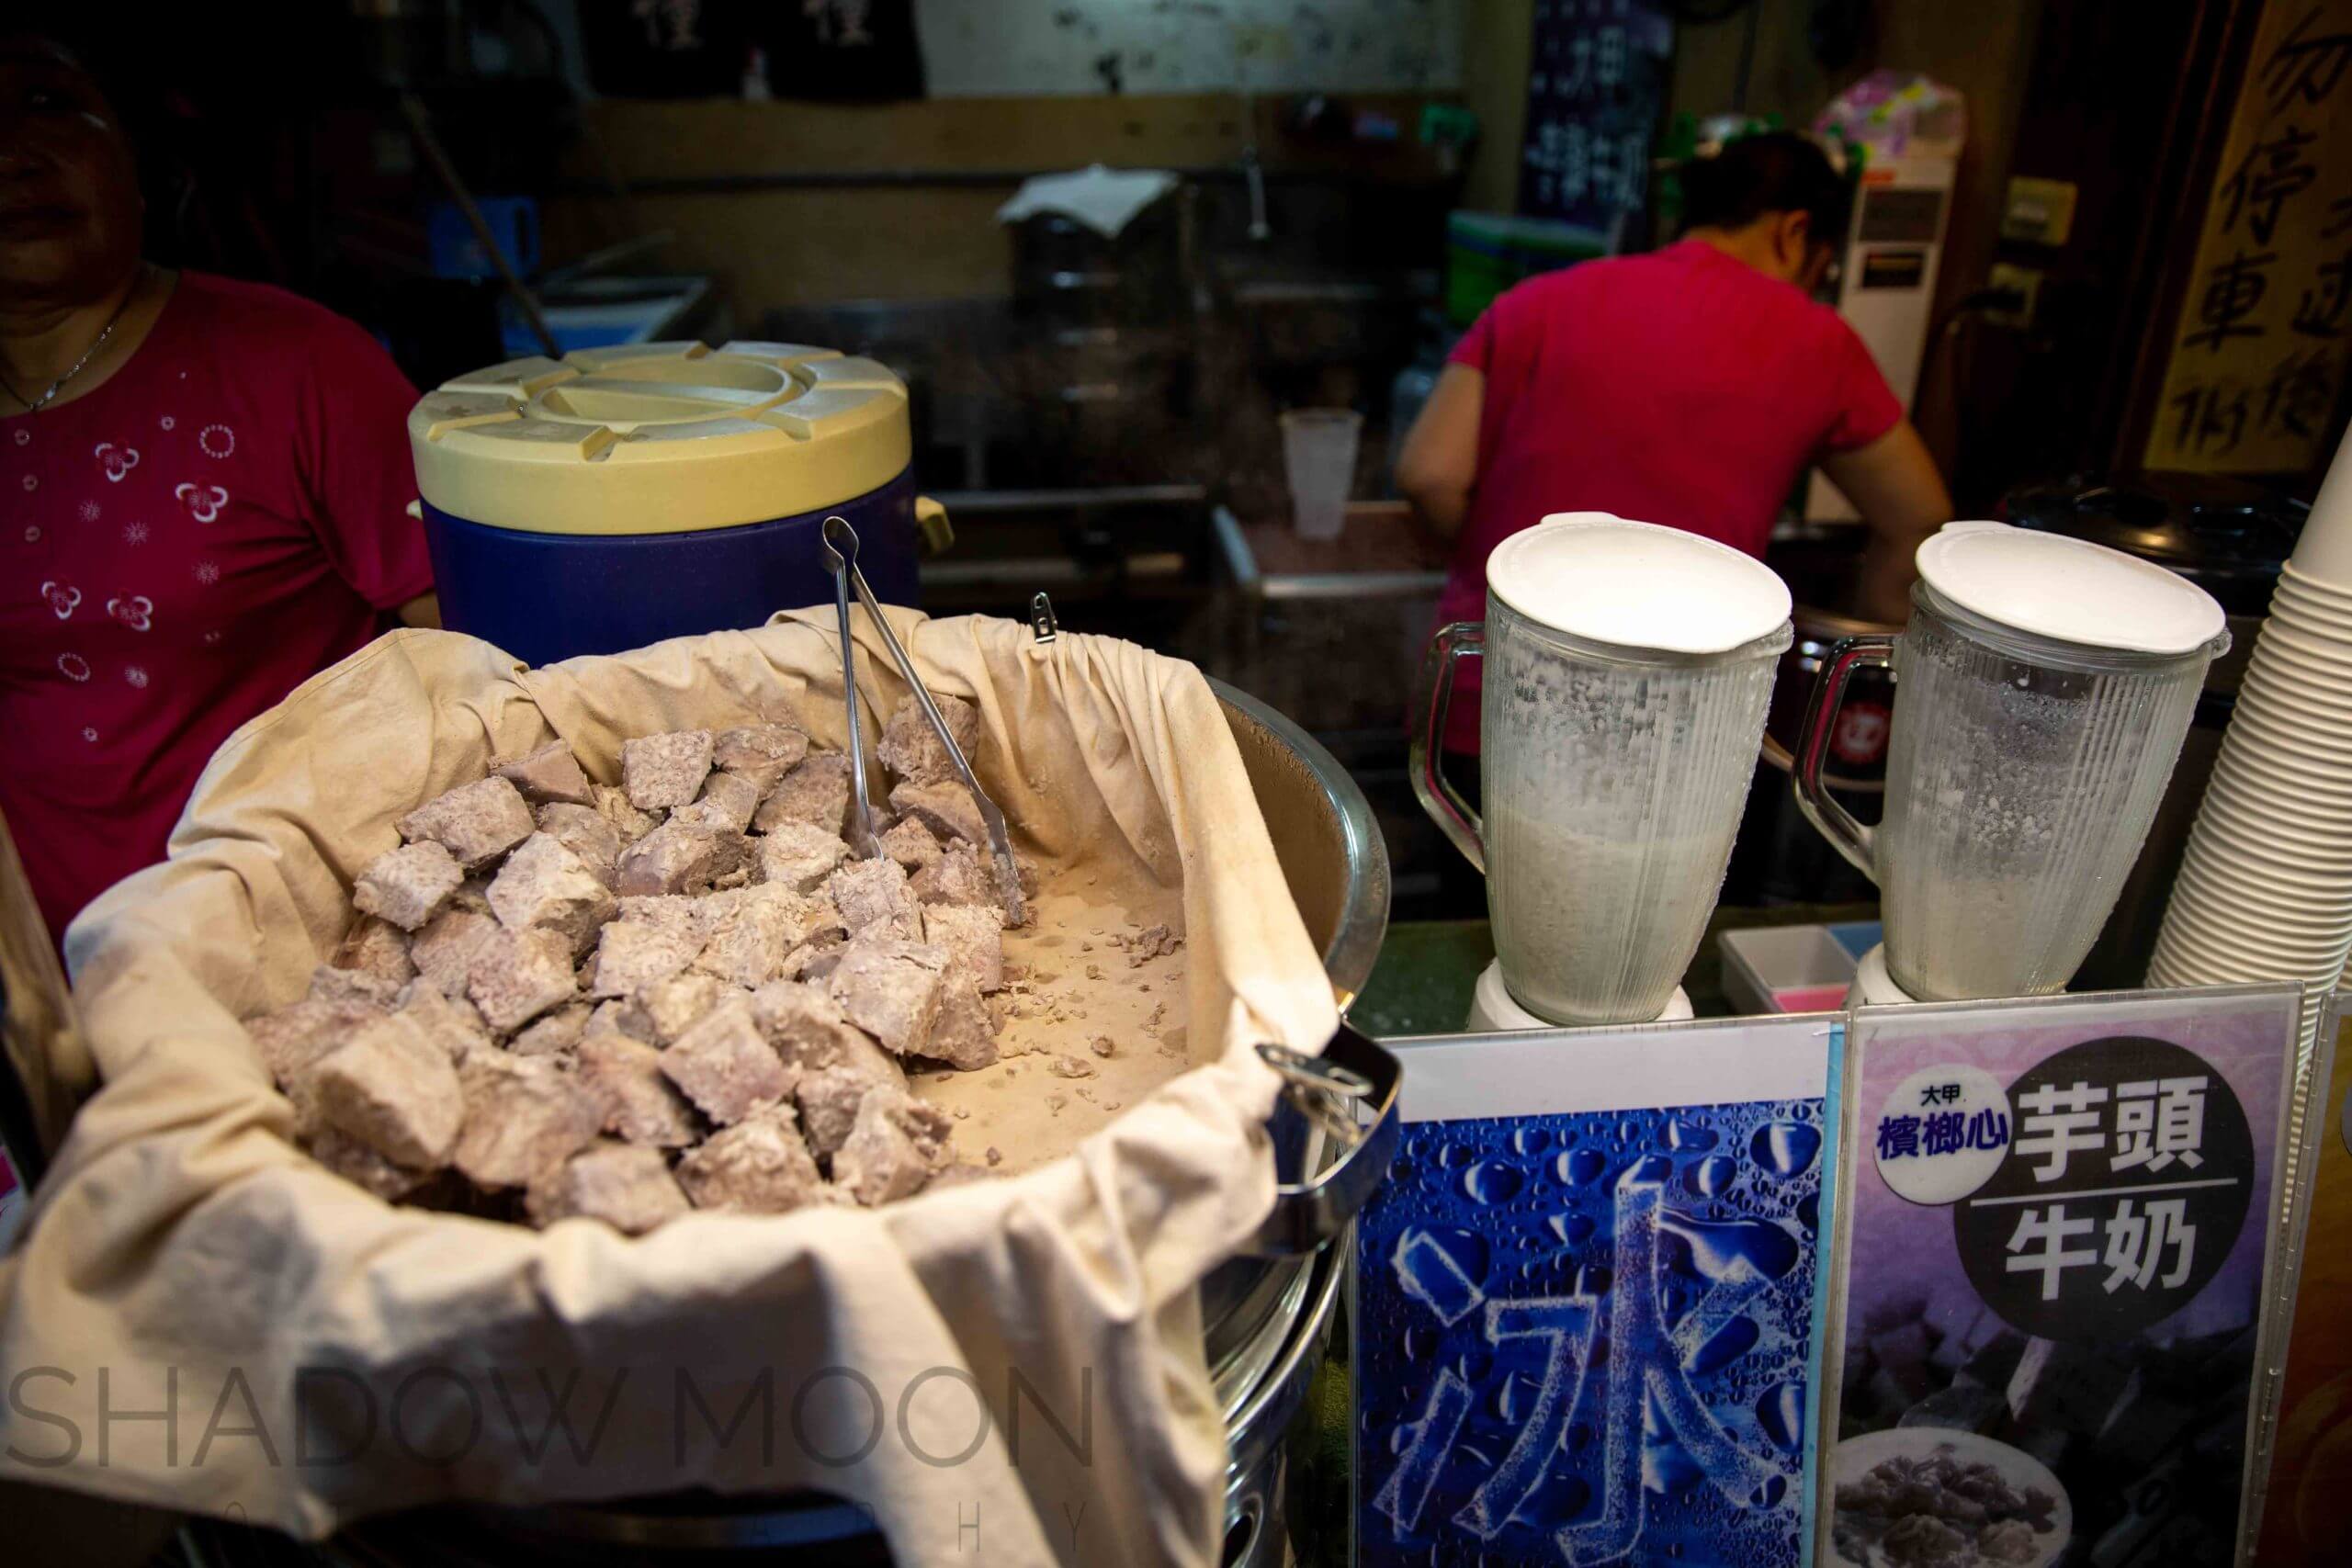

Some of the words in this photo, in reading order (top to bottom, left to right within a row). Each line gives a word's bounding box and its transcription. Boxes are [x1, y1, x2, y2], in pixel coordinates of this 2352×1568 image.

[1876, 1107, 2009, 1160] 檳榔心
[1920, 1083, 1961, 1107] 大甲
[2015, 1076, 2209, 1183] 芋頭
[2005, 1198, 2198, 1301] 牛奶
[1372, 1172, 1787, 1567] 冰
